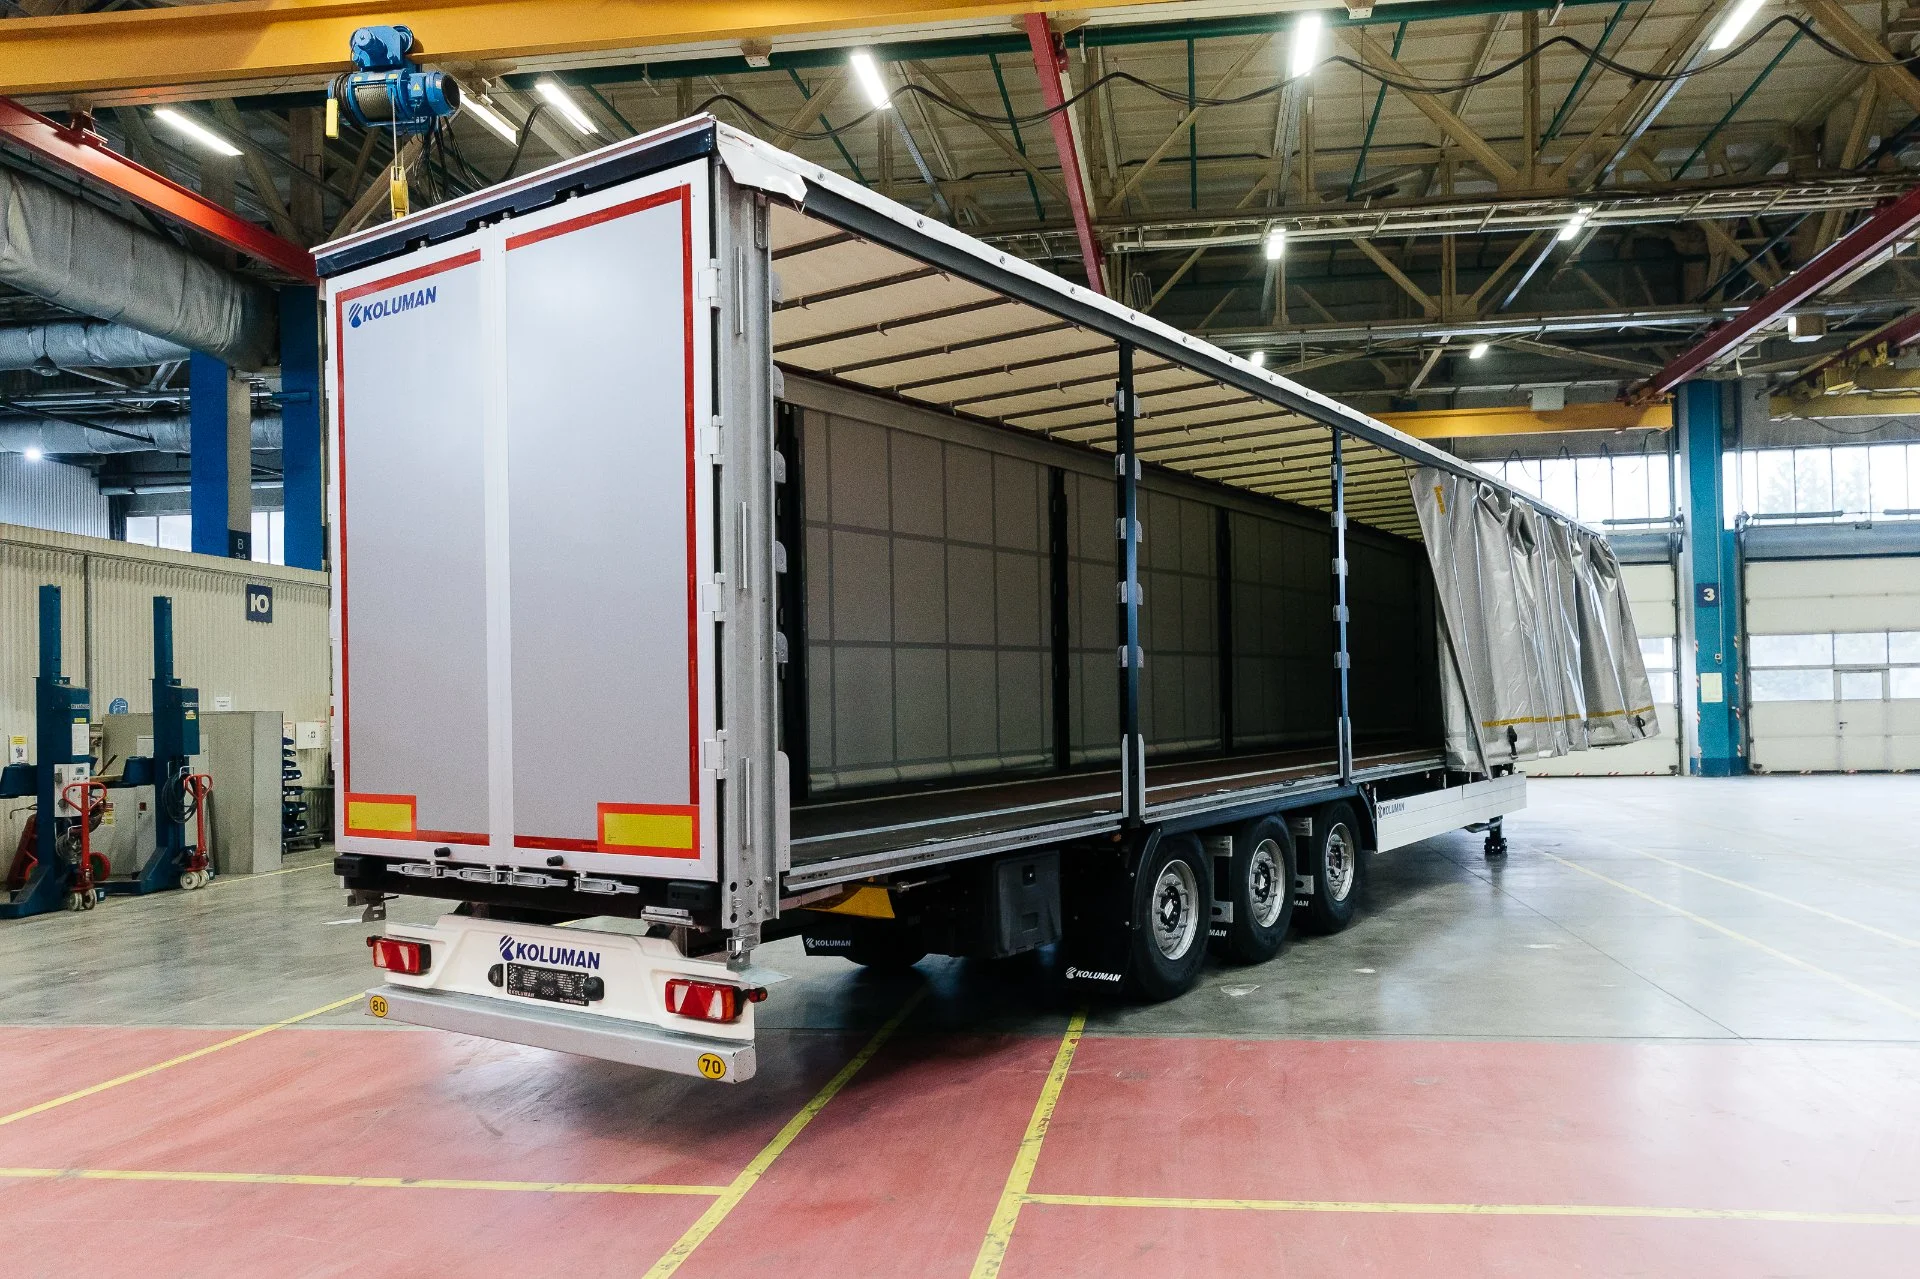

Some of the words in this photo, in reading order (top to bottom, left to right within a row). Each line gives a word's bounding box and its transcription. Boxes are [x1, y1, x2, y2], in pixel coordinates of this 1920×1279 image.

[363, 286, 436, 322] KOLUMAN
[1703, 588, 1716, 601] 3
[516, 943, 600, 969] KOLUMAN
[1076, 970, 1121, 982] KOLUMAN
[373, 1000, 386, 1013] 80
[703, 1058, 721, 1075] 70
